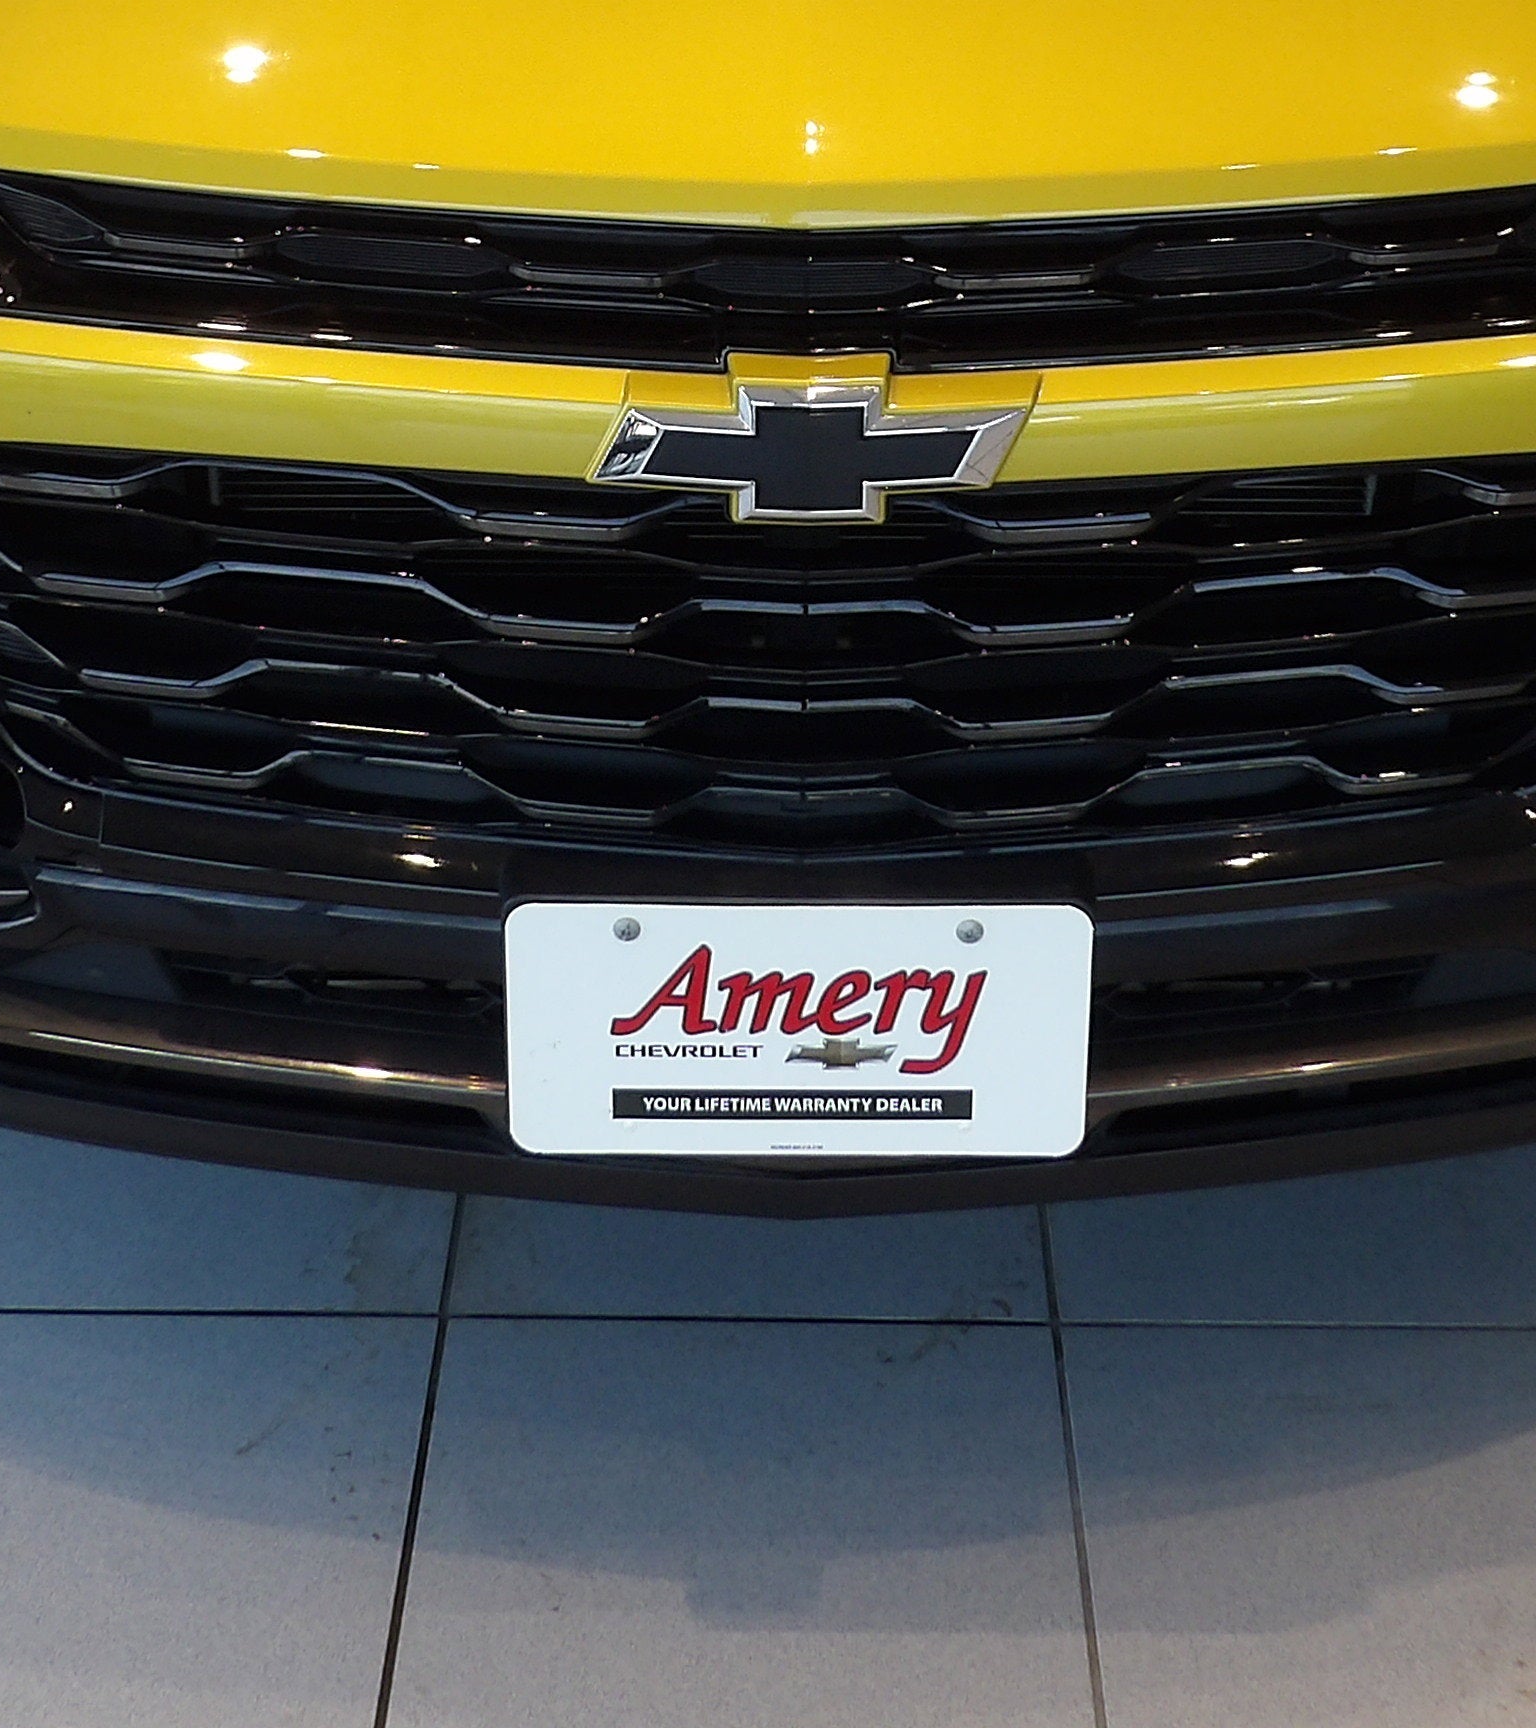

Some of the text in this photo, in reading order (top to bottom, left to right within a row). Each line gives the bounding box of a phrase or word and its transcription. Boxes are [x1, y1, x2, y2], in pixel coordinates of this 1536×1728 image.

[610, 943, 988, 1074] Amery
[615, 1044, 764, 1058] CHEVROLET
[642, 1097, 944, 1112] YOUR LIFETIME WARRANTY DEALER
